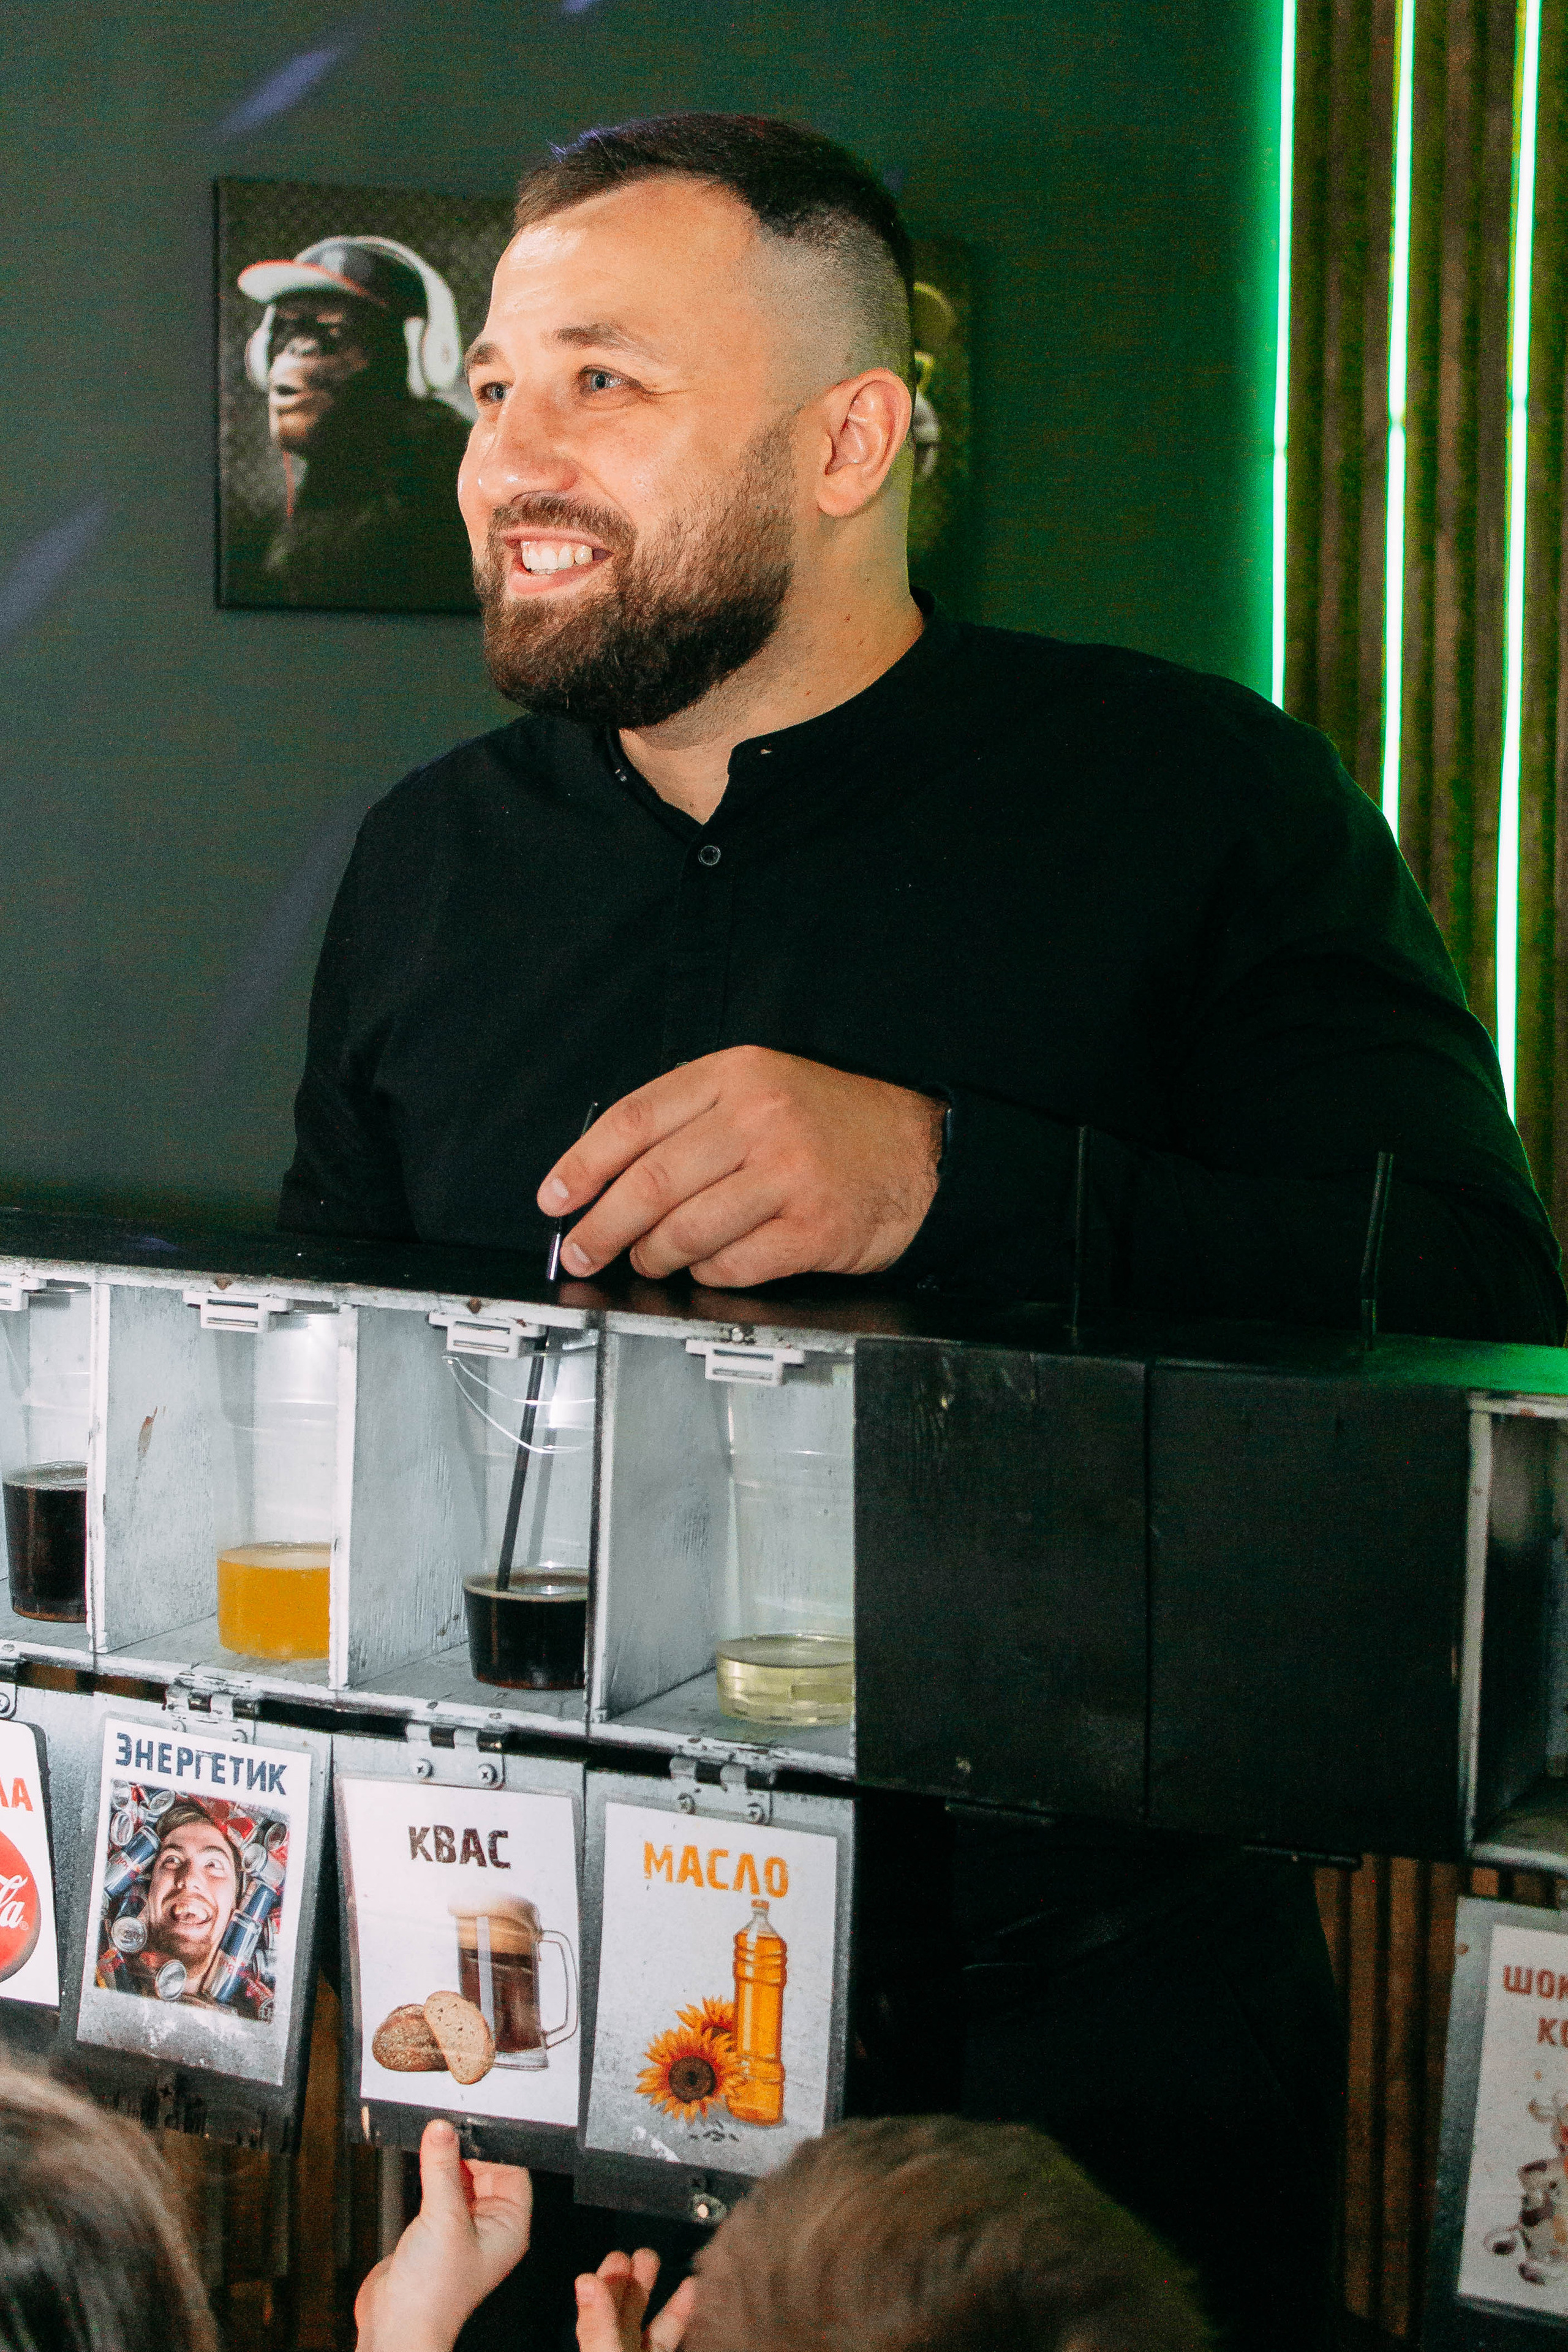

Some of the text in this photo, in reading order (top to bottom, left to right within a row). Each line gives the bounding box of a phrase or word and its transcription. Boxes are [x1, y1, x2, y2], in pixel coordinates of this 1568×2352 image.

[115, 1732, 288, 1796] ЭНЕРГЕТИК
[409, 1825, 511, 1869] КВАС
[643, 1841, 789, 1898] МАСЛО
